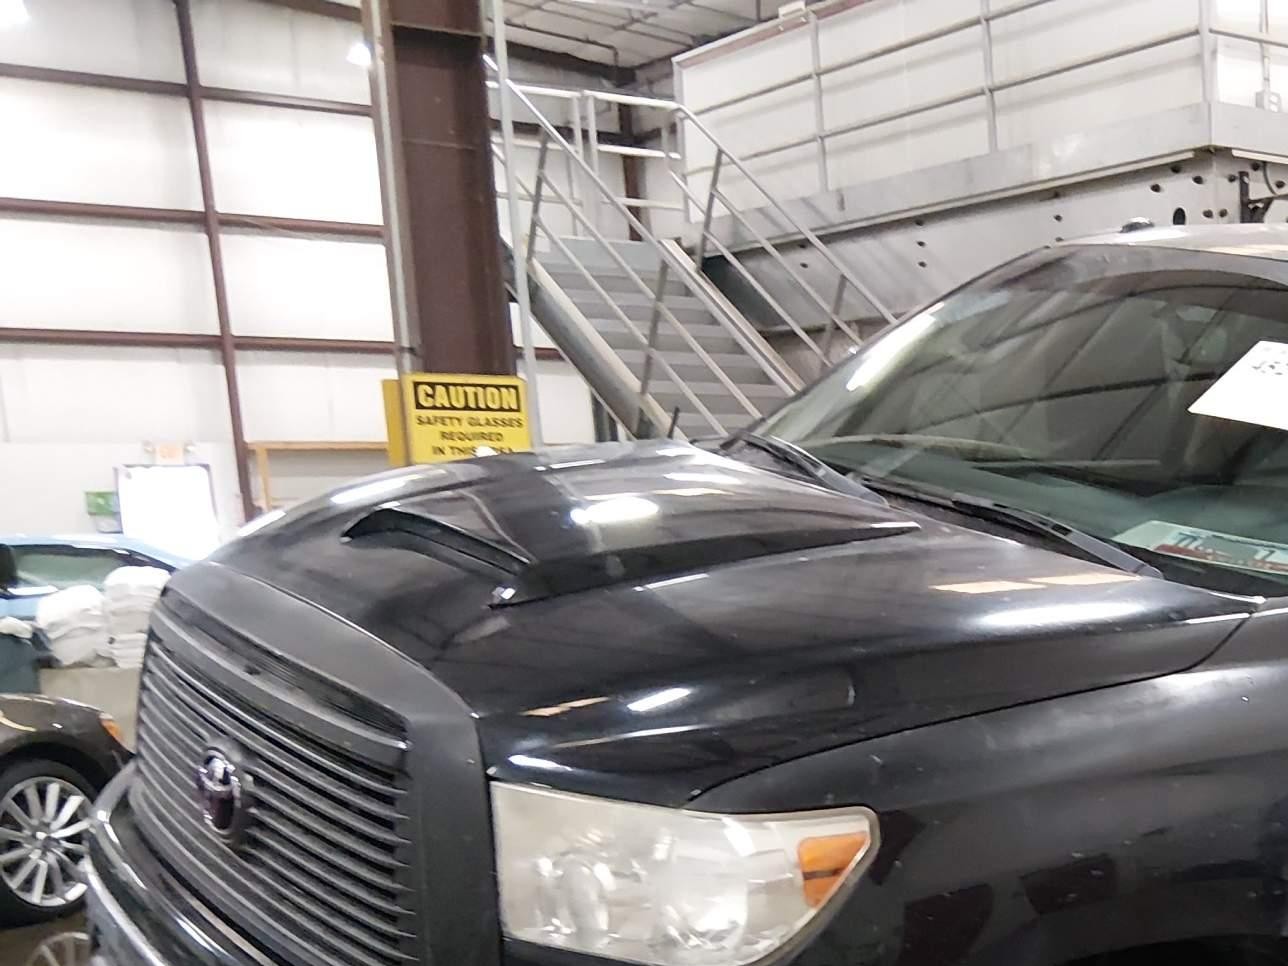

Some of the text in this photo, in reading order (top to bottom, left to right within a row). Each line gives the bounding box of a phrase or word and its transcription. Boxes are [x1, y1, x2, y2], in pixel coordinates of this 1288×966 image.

[416, 384, 519, 410] CAUTION
[416, 415, 524, 428] SAFETY GLASSES
[440, 431, 503, 442] REQUIRED
[432, 446, 446, 455] IN
